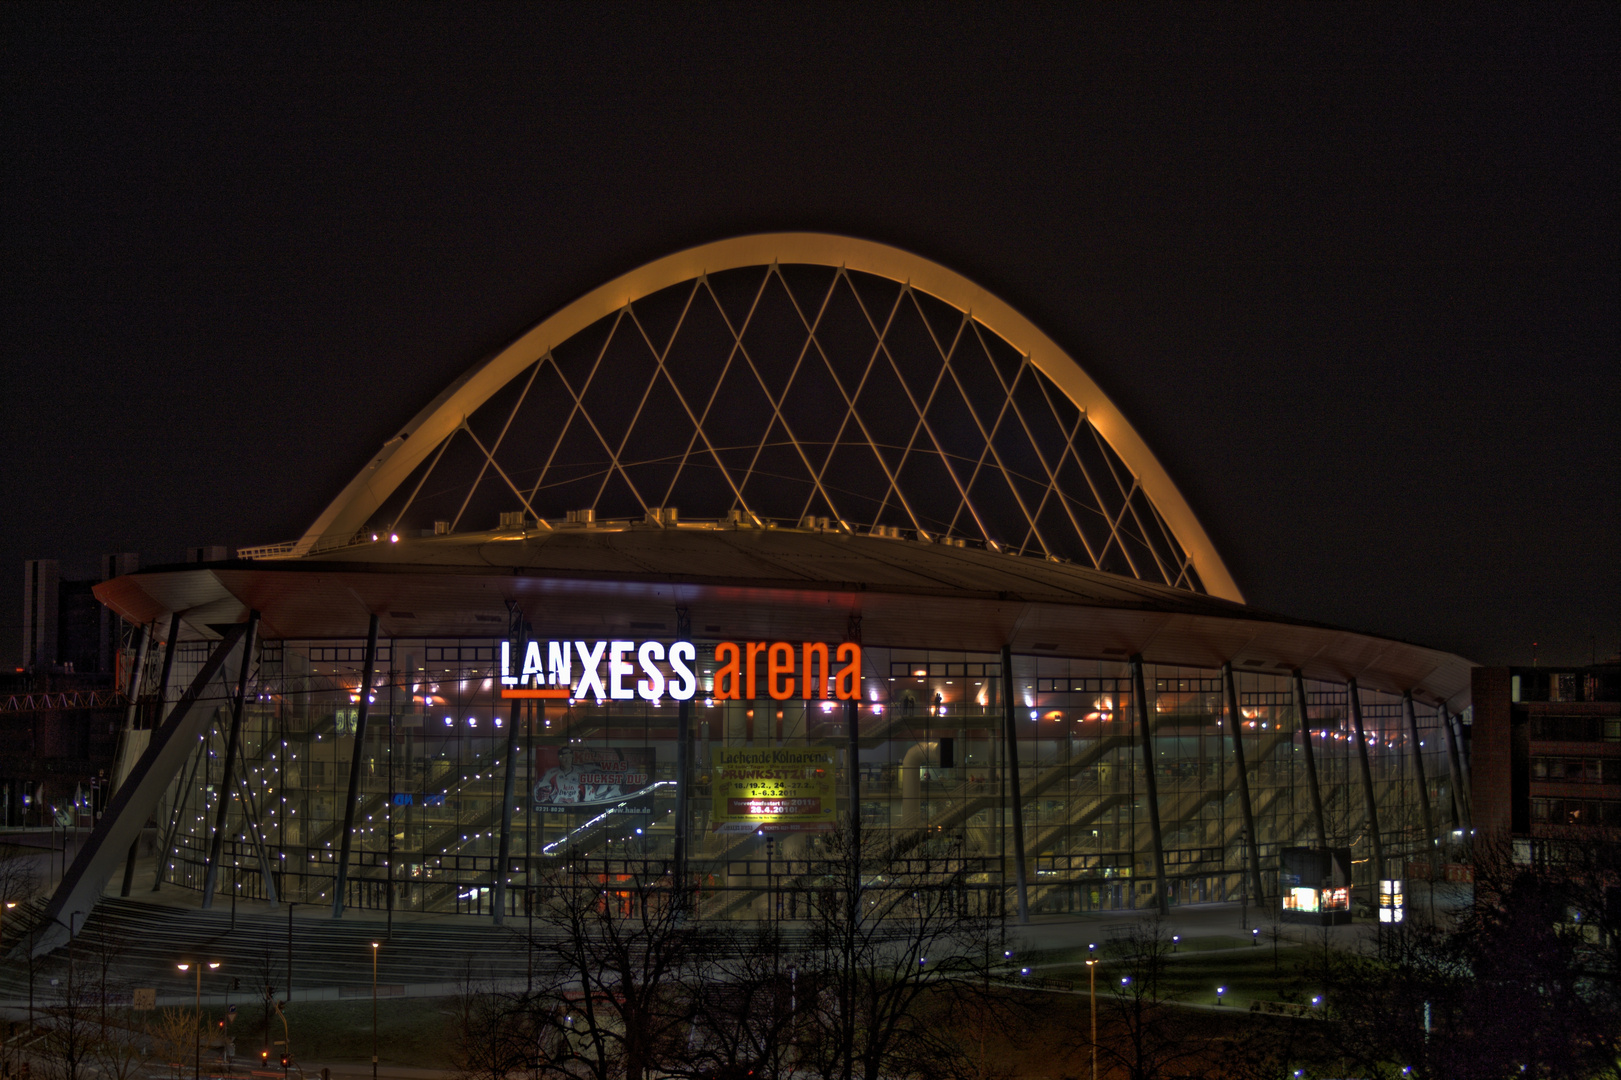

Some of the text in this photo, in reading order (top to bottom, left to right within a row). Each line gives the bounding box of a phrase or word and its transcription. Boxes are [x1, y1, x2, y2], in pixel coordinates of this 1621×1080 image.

[501, 640, 862, 701] LANXESS arena
[720, 750, 828, 764] Lachende Kölnarena
[600, 761, 628, 771] WAS
[579, 774, 648, 785] GUCKST DU?
